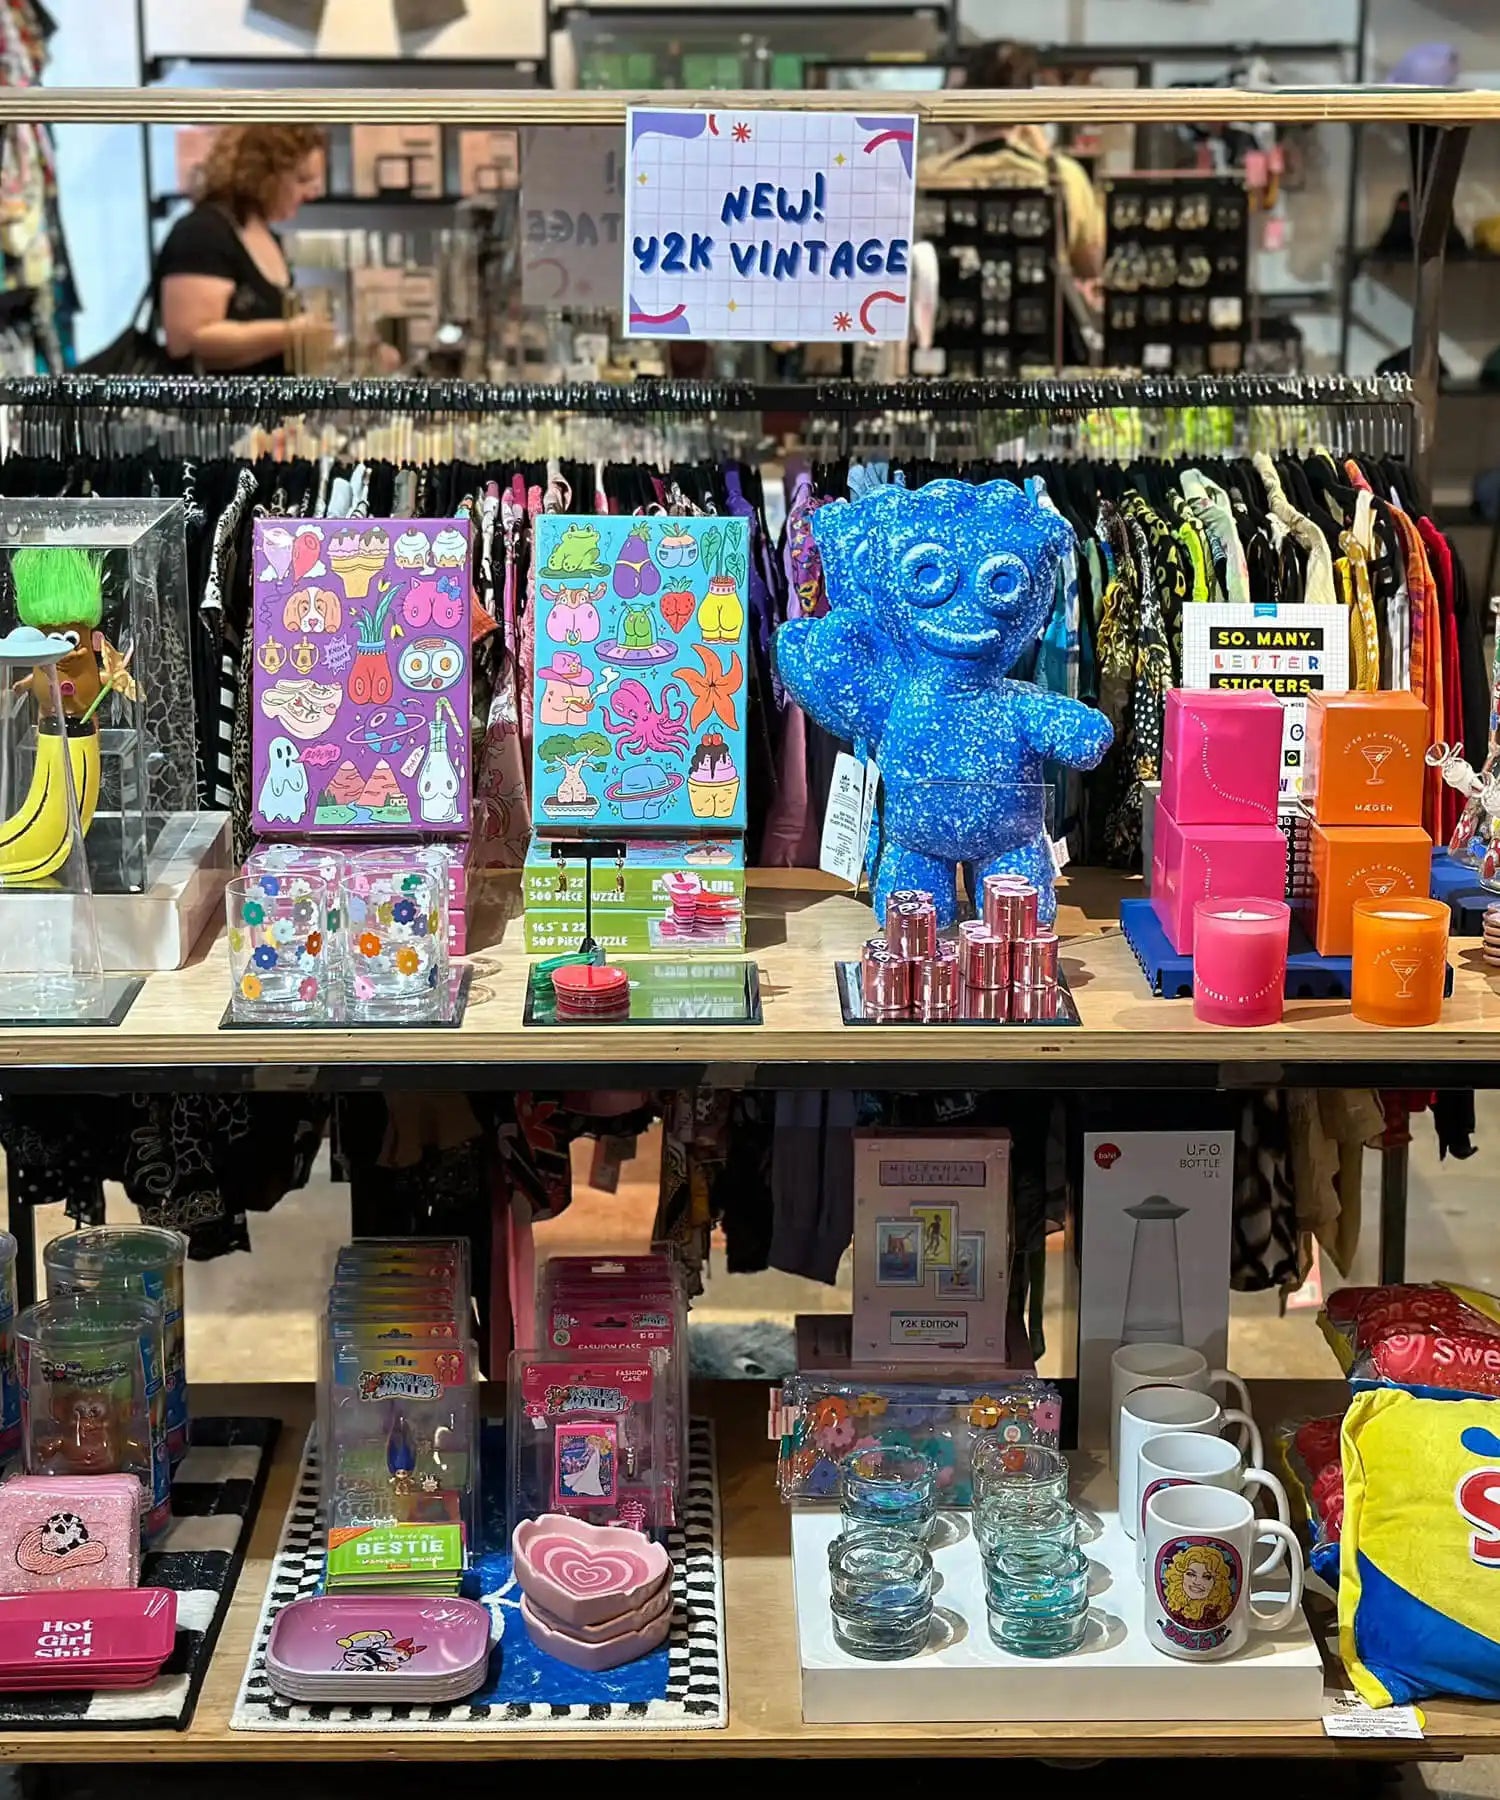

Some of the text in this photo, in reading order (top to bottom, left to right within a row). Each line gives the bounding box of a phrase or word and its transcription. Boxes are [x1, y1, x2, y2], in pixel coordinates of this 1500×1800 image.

[721, 172, 826, 225] NEW!
[633, 231, 908, 281] Y2K VINTAGE
[1218, 631, 1316, 647] SO. MANY.
[1214, 654, 1320, 670] LETTER
[1218, 678, 1312, 693] STICKERS
[529, 891, 552, 902] 500
[591, 892, 625, 903] UZZLE
[532, 936, 554, 947] 500
[593, 937, 629, 947] UZZLE
[1180, 1159, 1220, 1169] BOTTLE
[899, 1319, 959, 1329] Y2K EDITION
[615, 1369, 648, 1377] FASHION
[356, 1540, 445, 1555] BESTIE
[42, 1619, 94, 1633] Hot
[37, 1632, 92, 1646] Girl
[34, 1646, 94, 1658] Shit
